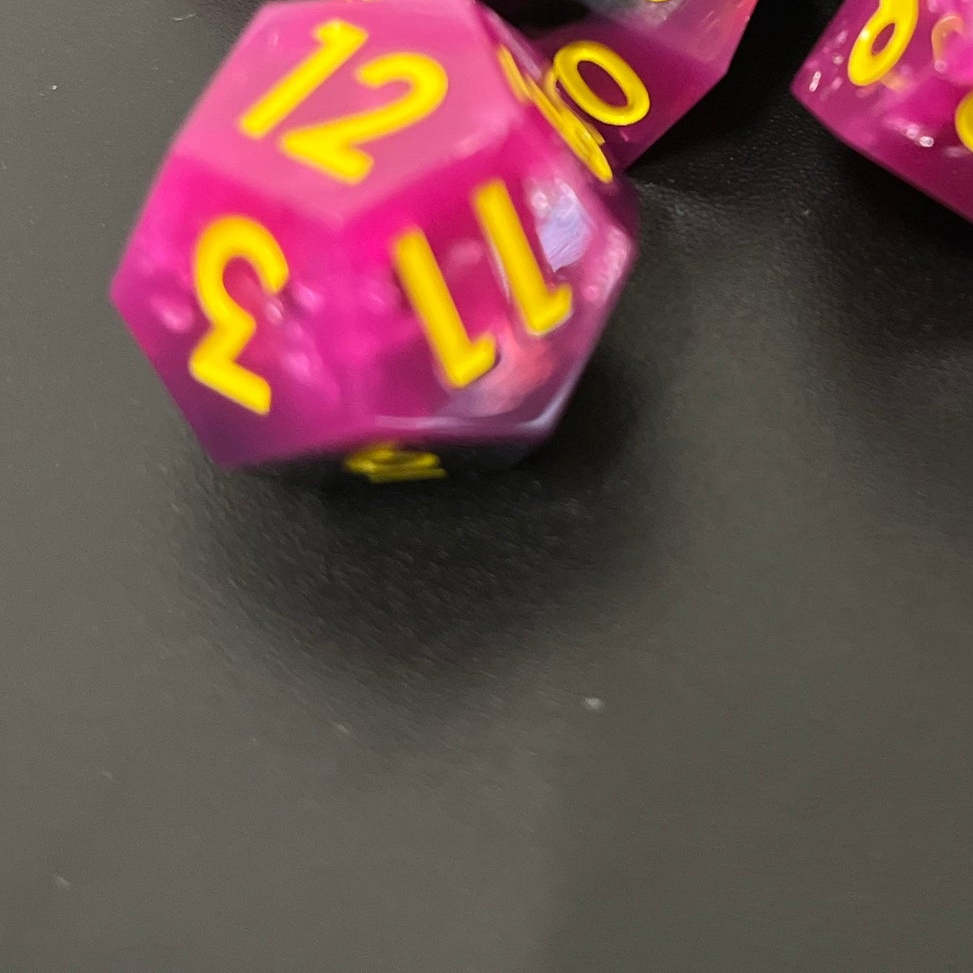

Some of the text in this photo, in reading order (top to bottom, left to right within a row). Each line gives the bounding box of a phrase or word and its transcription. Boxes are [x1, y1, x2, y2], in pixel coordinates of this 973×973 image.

[238, 18, 450, 185] 12
[188, 214, 289, 416] 3
[389, 178, 574, 390] 11
